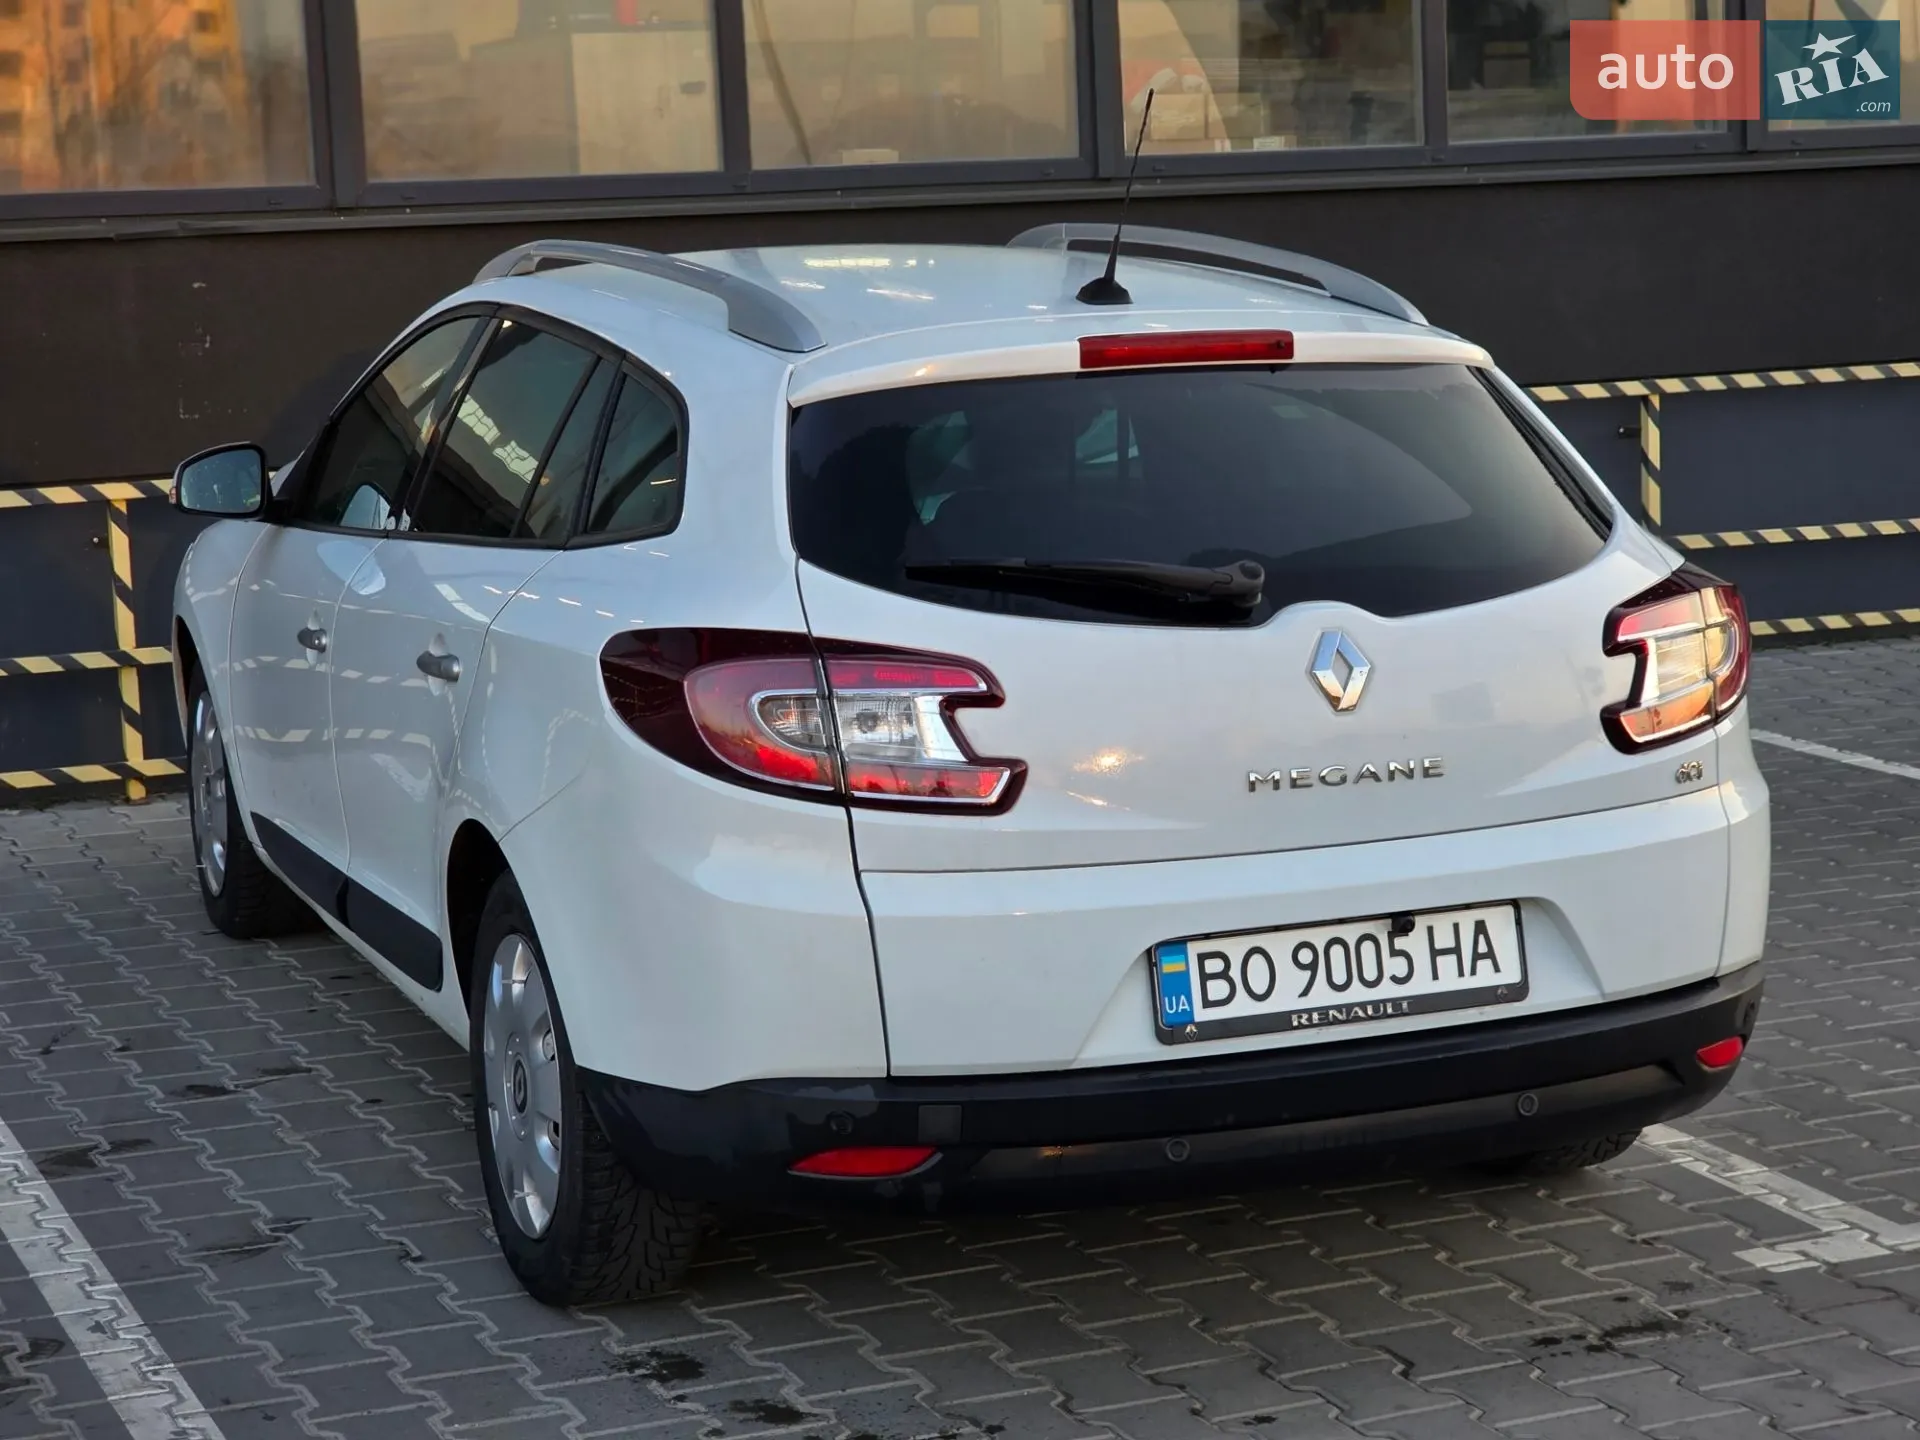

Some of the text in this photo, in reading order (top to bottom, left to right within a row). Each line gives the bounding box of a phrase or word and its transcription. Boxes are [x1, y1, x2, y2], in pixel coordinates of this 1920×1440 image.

[1247, 756, 1445, 793] MEGANE
[1196, 918, 1501, 1010] BO 9005 HA
[1164, 996, 1191, 1015] UA
[1290, 999, 1414, 1028] RENAULT
